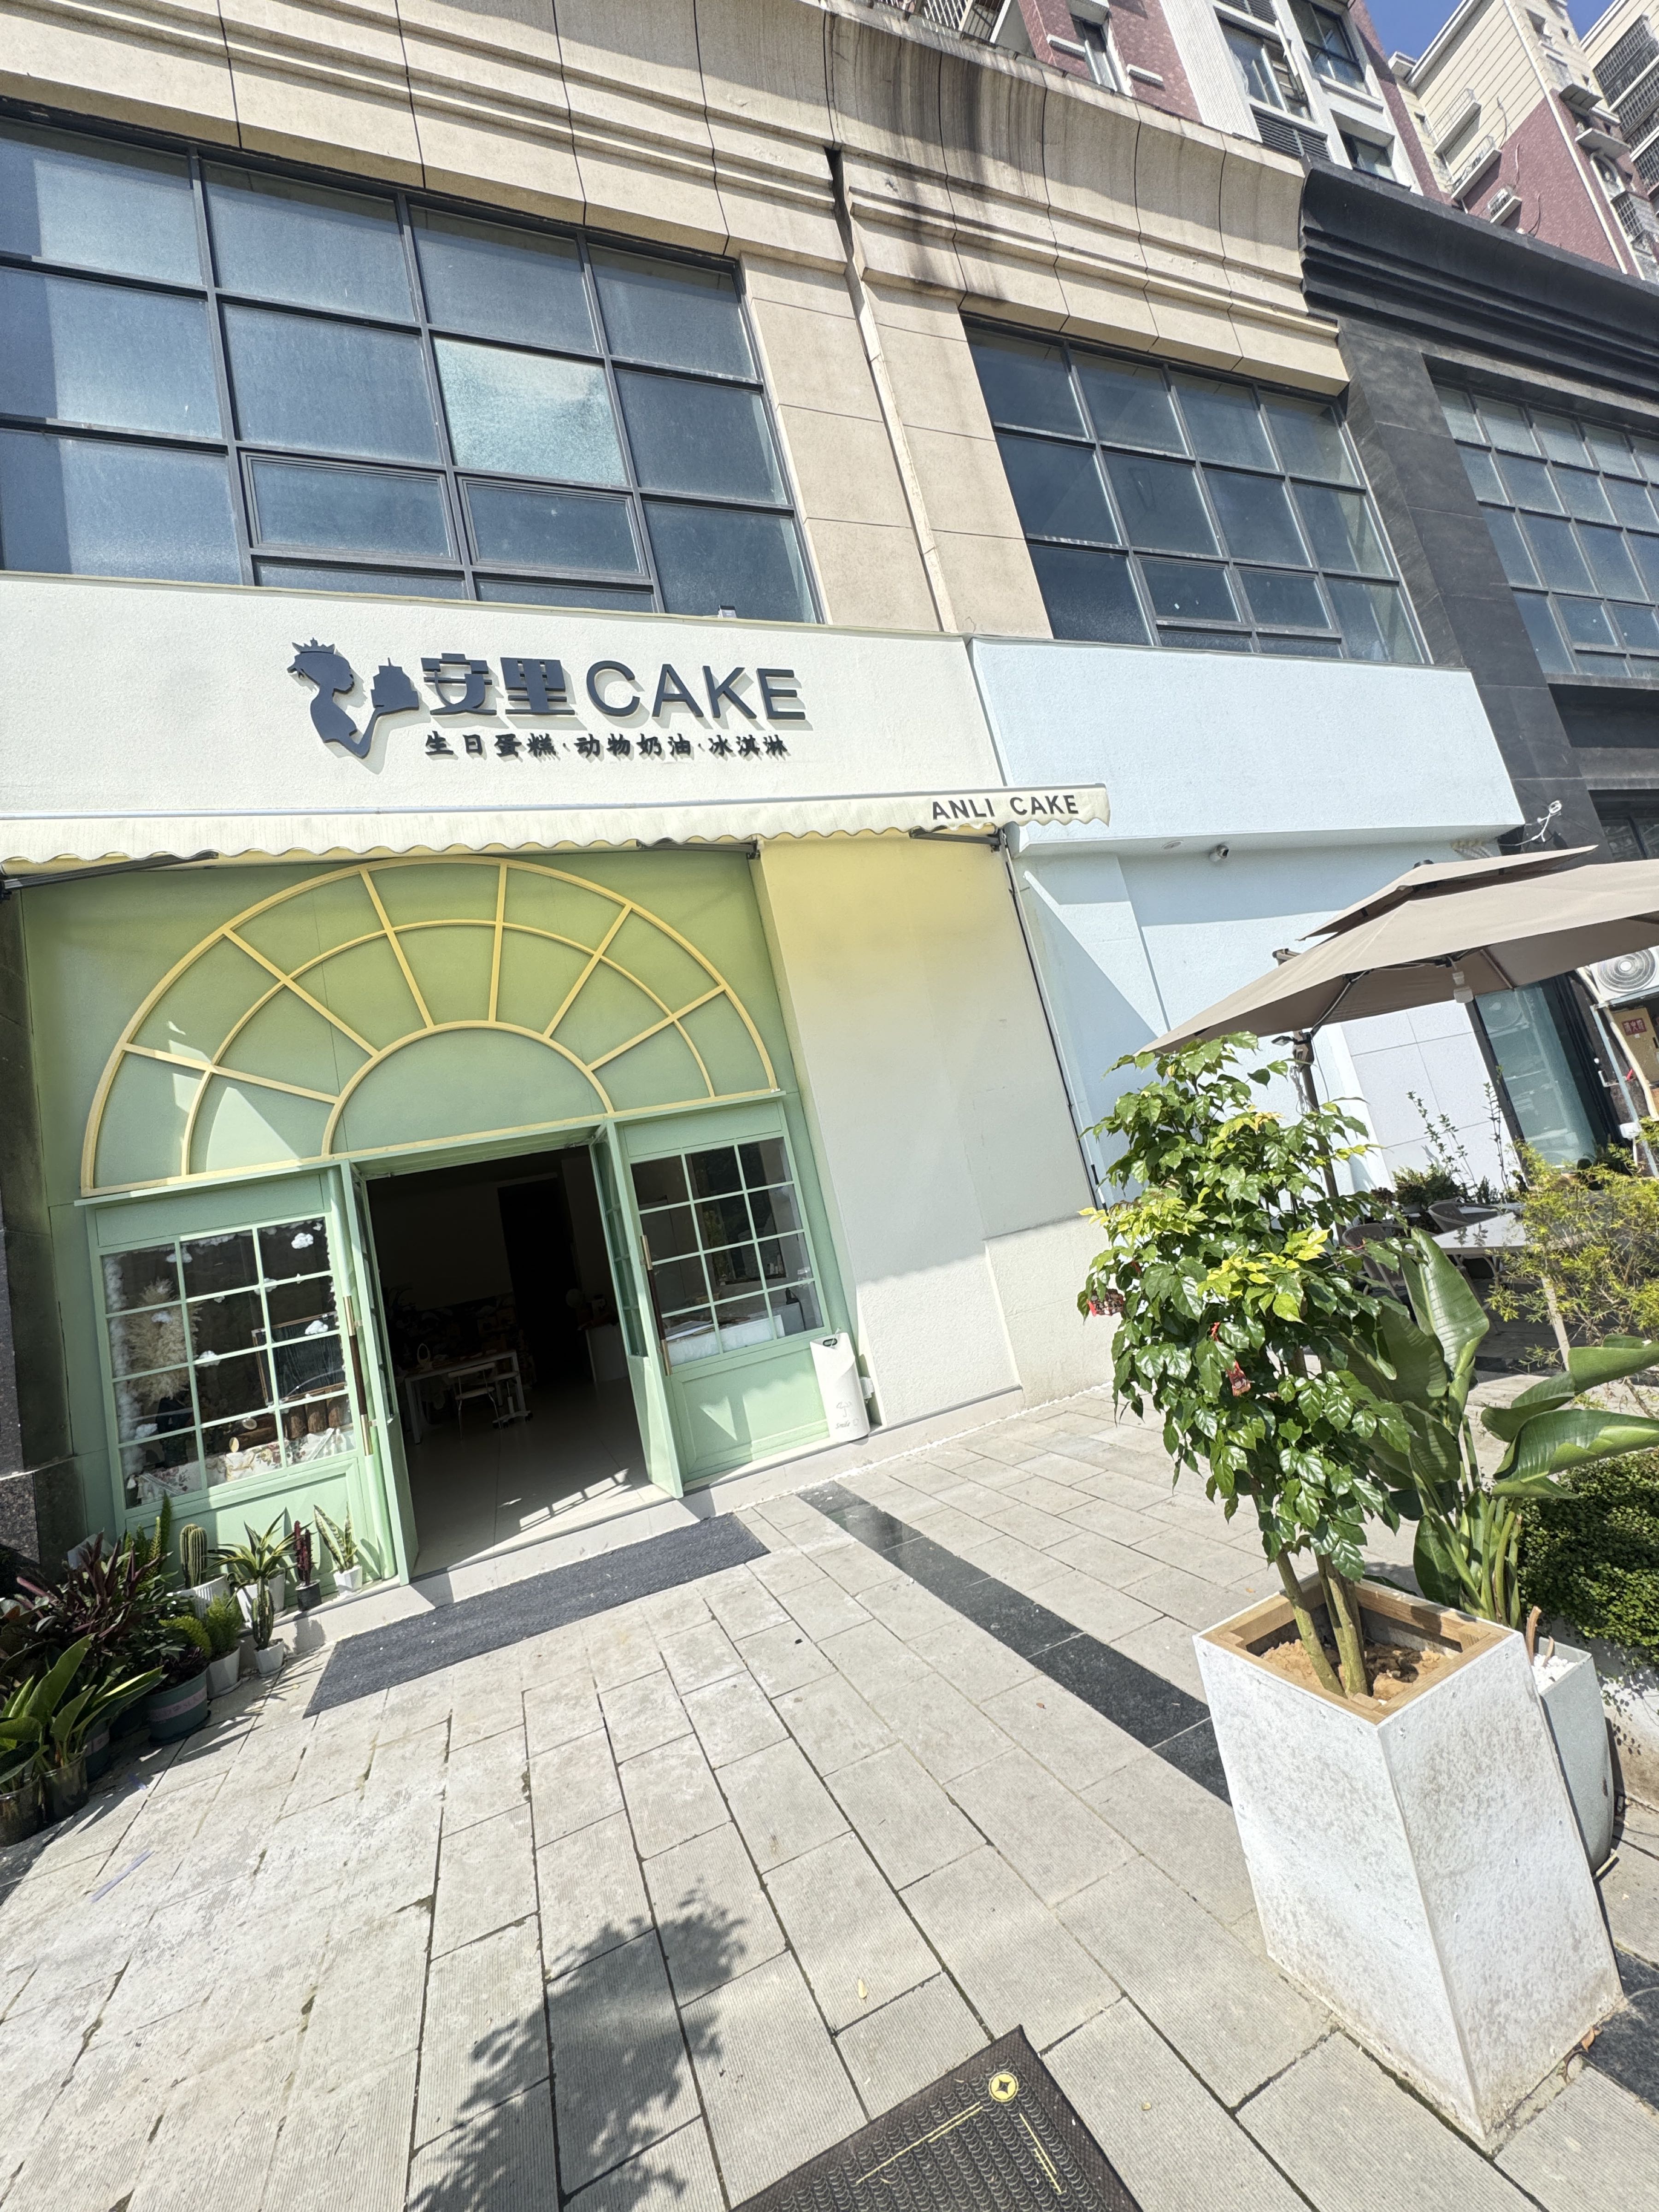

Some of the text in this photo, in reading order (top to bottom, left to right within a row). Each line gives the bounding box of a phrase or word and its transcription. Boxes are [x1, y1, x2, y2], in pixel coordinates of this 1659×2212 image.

[587, 660, 806, 720] CAKE
[932, 794, 1079, 820] ANLI CAKE
